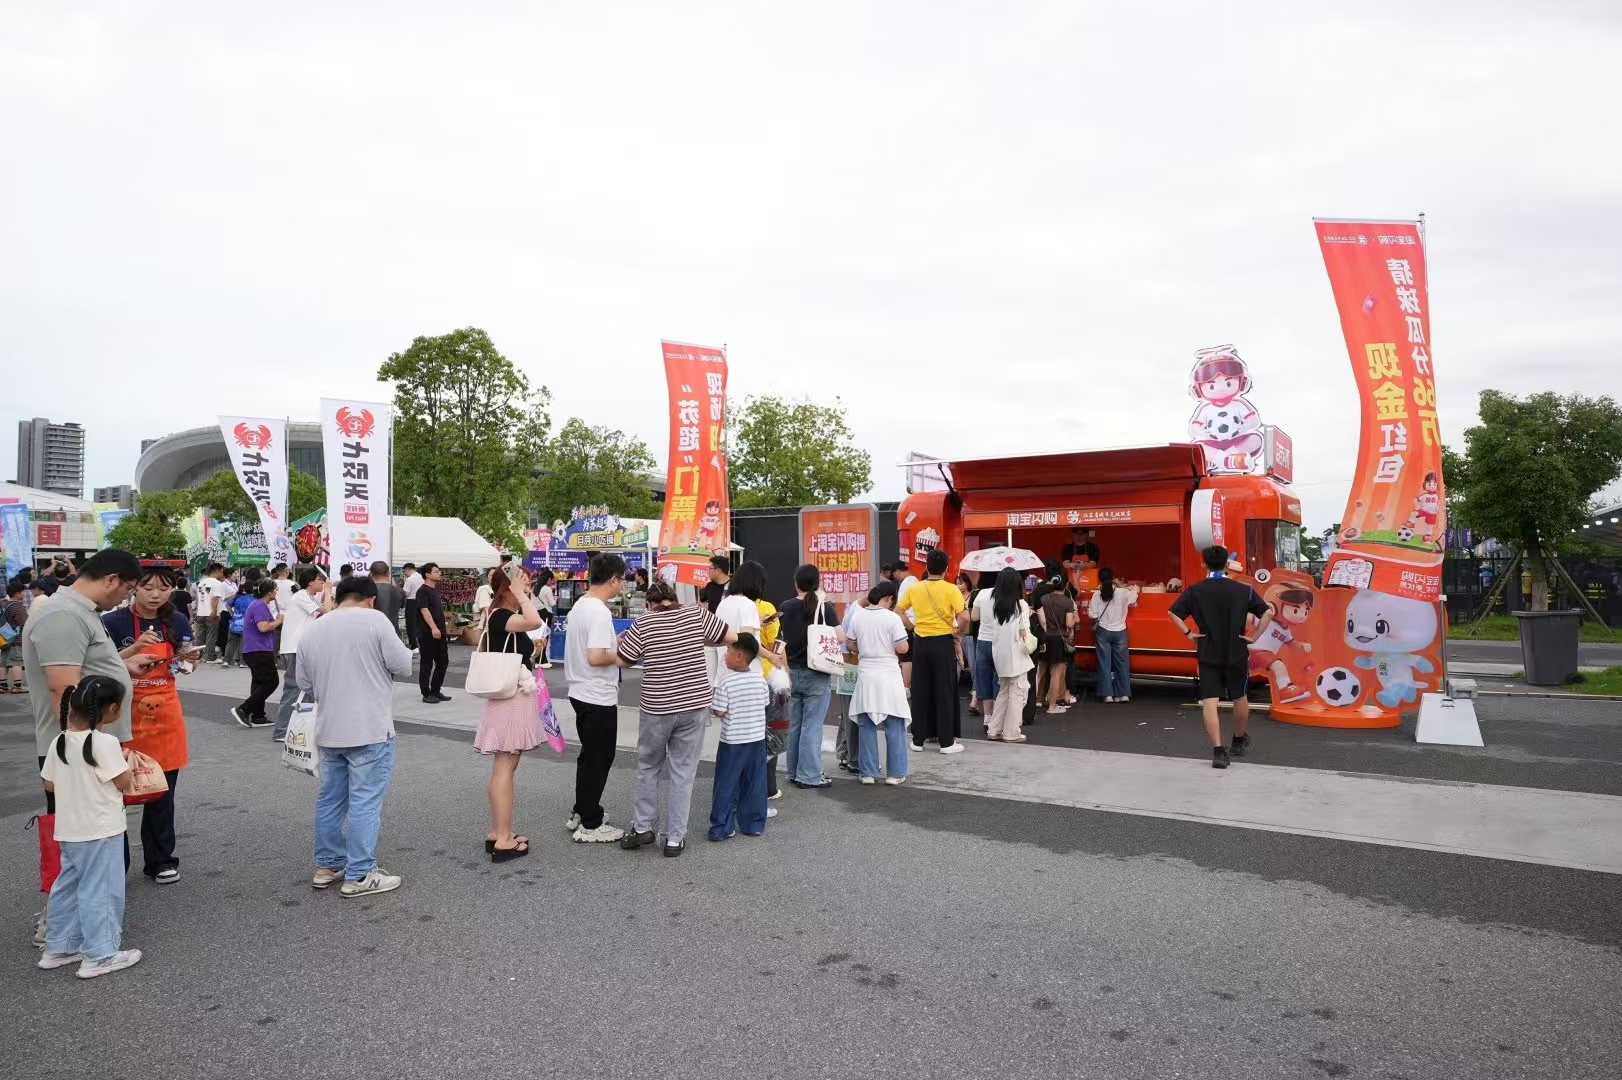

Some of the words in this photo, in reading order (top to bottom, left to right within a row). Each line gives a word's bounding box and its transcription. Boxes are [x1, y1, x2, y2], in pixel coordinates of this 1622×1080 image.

[1006, 512, 1058, 527] 淘宝闪购
[809, 533, 866, 552] 上淘宝闪购搜
[818, 554, 857, 571] 江苏足球
